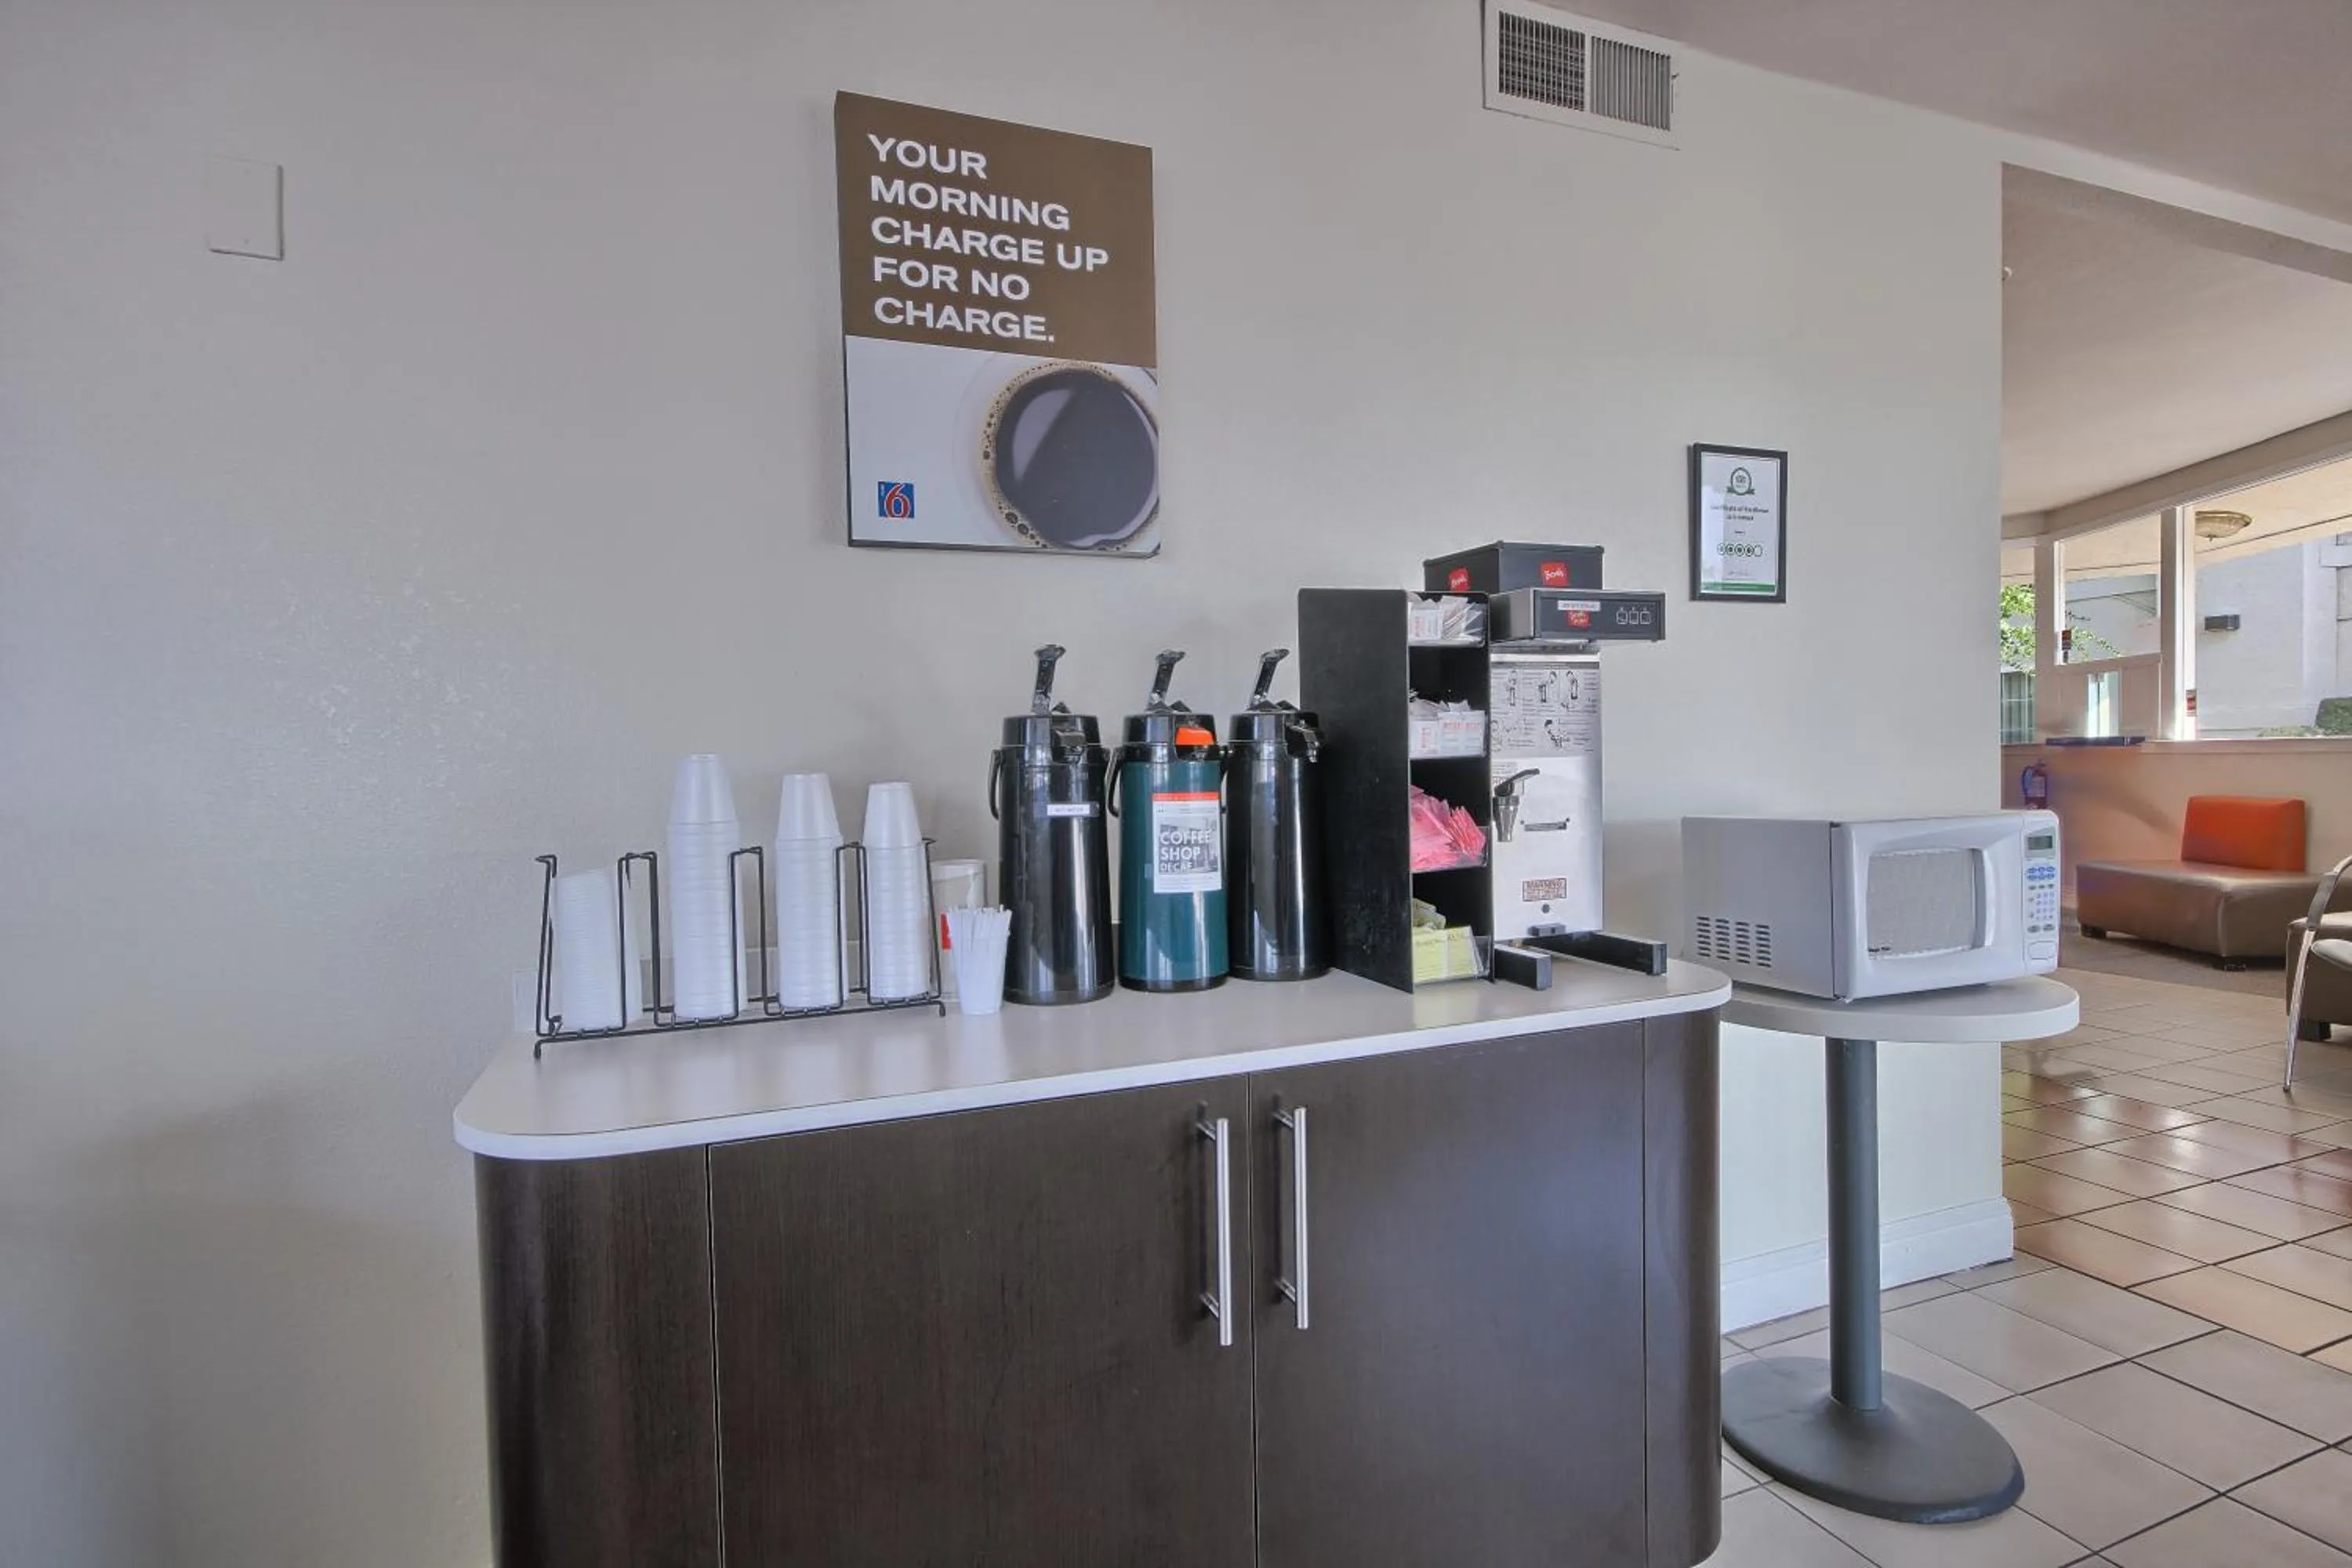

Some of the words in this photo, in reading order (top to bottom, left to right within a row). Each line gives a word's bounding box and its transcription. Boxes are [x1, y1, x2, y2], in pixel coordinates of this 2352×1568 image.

[867, 133, 987, 180] YOUR
[870, 175, 1070, 231] MORNING
[871, 216, 1045, 265] CHARGE
[1056, 242, 1109, 273] UP
[873, 256, 959, 292] FOR
[971, 269, 1030, 300] NO
[874, 297, 1054, 343] CHARGE.
[884, 483, 910, 520] 6
[1160, 829, 1212, 845] COFFEE
[1160, 846, 1201, 861] SHOP
